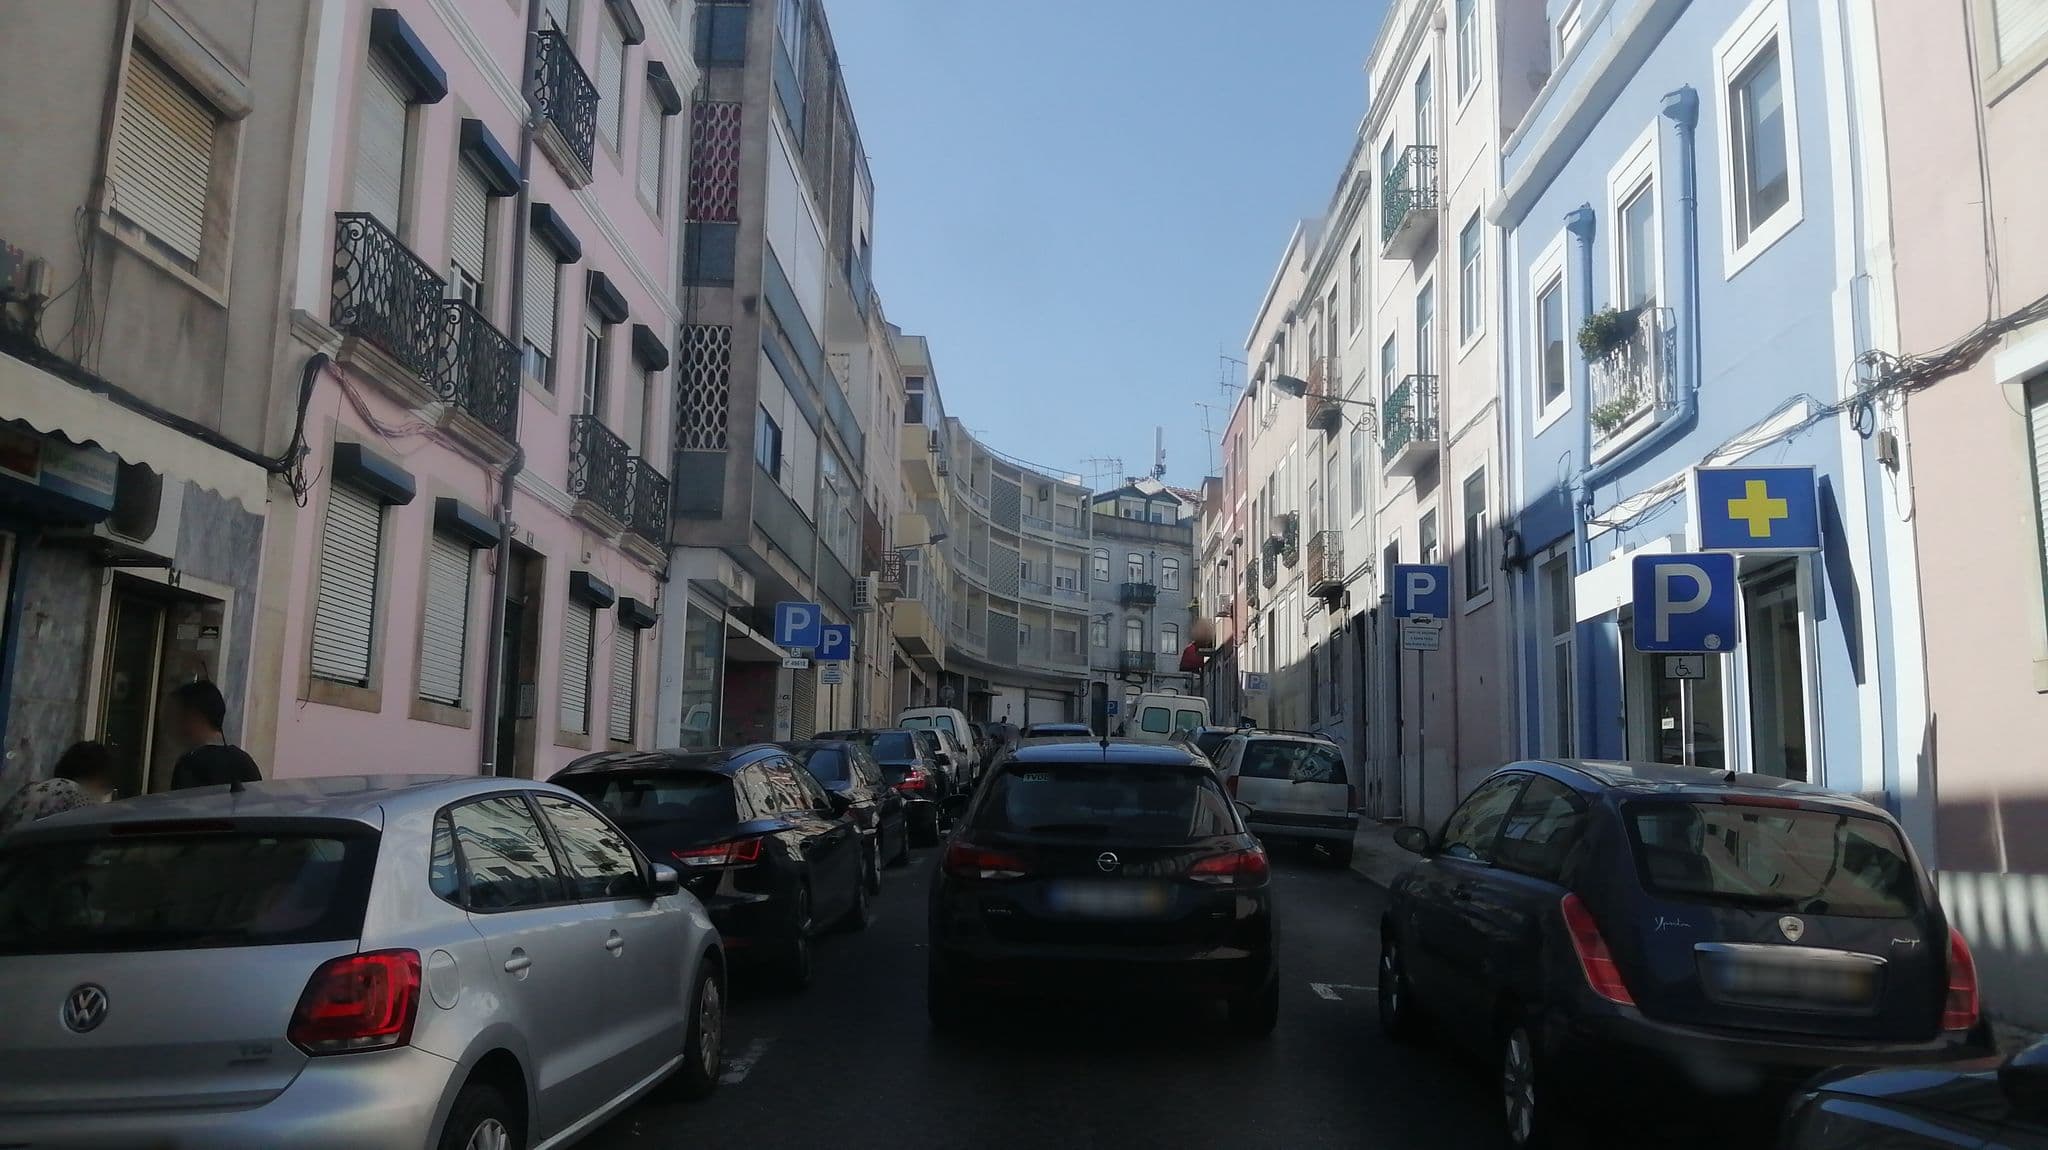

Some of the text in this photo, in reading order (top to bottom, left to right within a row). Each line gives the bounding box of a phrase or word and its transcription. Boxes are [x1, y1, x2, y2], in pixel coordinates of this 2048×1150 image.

[1407, 573, 1436, 610] P
[1655, 564, 1712, 642] P
[785, 607, 810, 641] P
[824, 630, 842, 654] P
[1107, 702, 1115, 713] P
